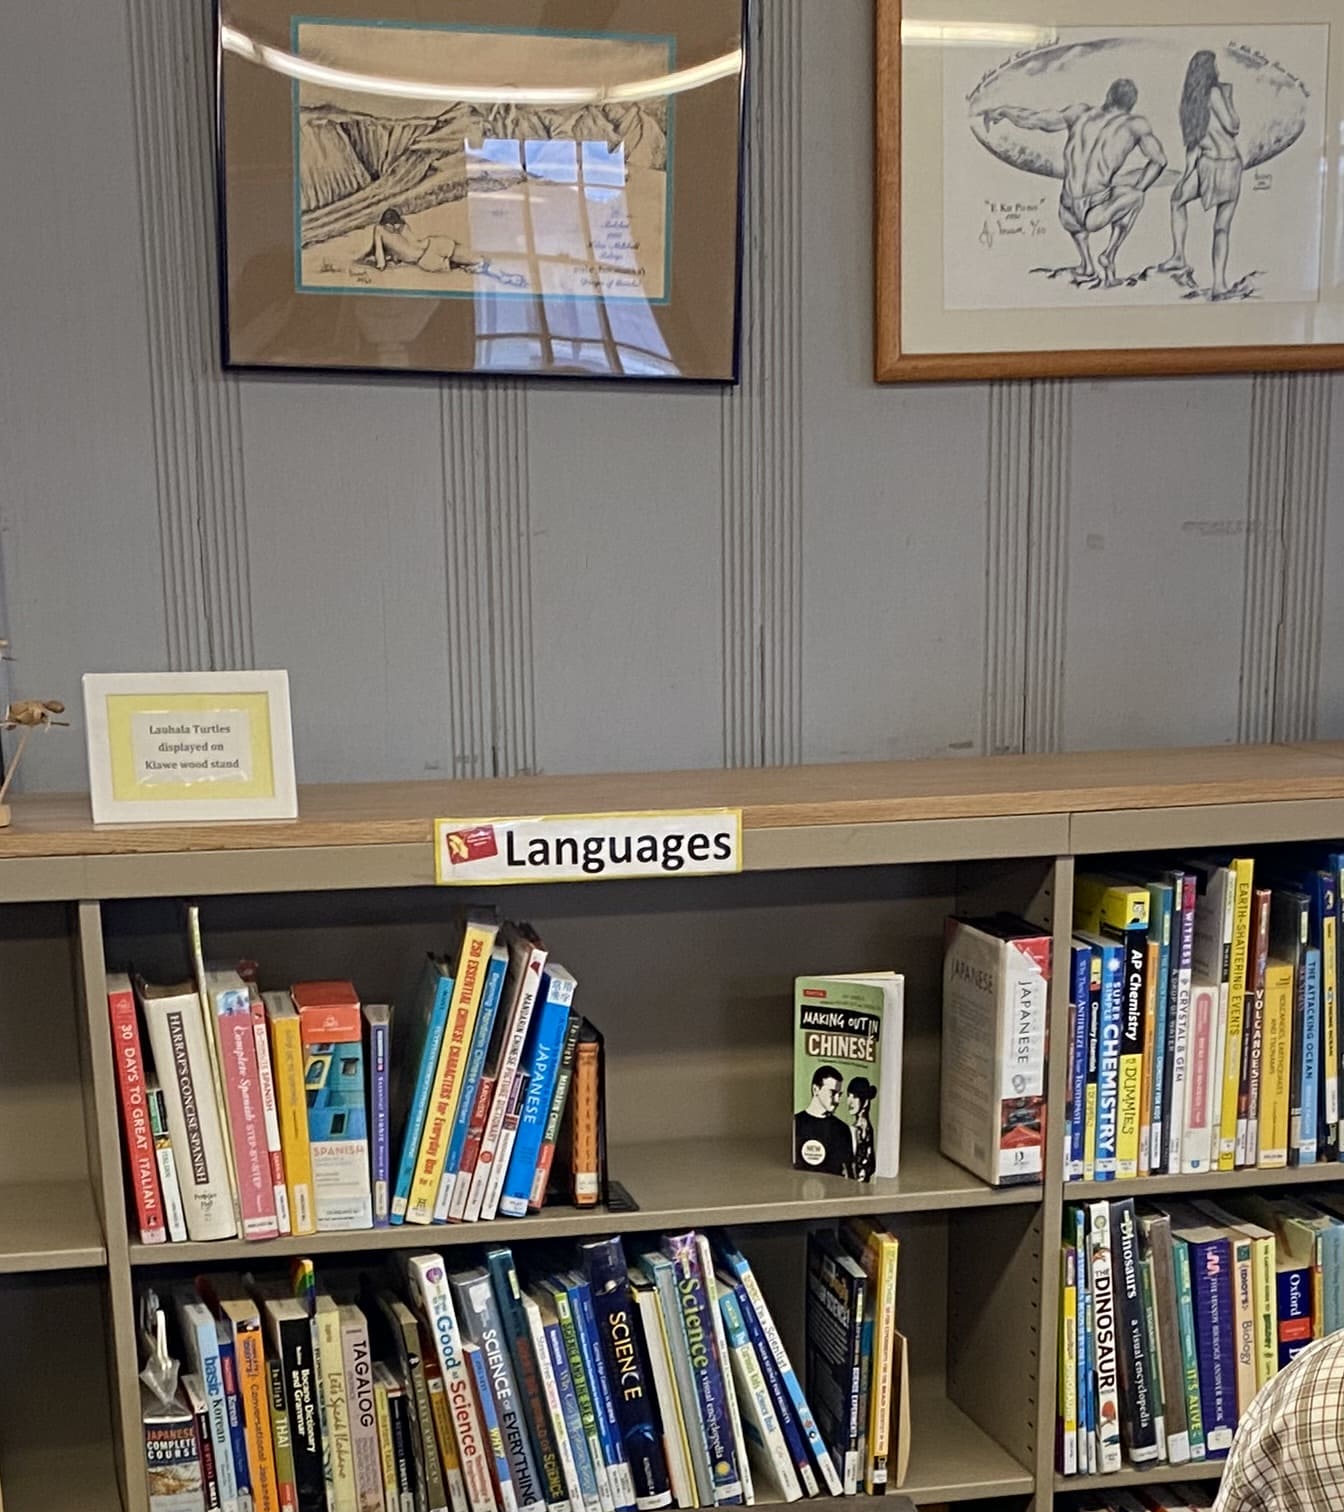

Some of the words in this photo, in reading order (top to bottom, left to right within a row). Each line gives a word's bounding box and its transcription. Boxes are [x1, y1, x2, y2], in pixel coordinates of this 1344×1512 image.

[150, 725, 190, 734] Lauhala
[192, 725, 231, 733] Turtles
[159, 742, 208, 754] displayed
[180, 760, 208, 768] wood
[211, 760, 239, 768] stand
[507, 831, 731, 873] Languages
[1132, 950, 1143, 968] AP
[1308, 962, 1316, 981] THE
[803, 1012, 845, 1027] MAKING
[848, 1018, 866, 1031] OUT
[1018, 980, 1029, 1065] JAPANESE
[1126, 970, 1142, 1040] Chemistry
[1307, 985, 1315, 1041] ATTACKING
[120, 1025, 133, 1040] 30
[808, 1035, 874, 1061] CHINESE
[124, 1049, 139, 1082] DAYS
[1305, 1044, 1314, 1079] OCEAN
[129, 1086, 141, 1105] TO
[523, 1044, 550, 1124] JAPANESE
[1099, 1024, 1119, 1152] CHEMISTRY
[133, 1110, 147, 1149] GREAT
[139, 1159, 155, 1209] ITALIAN
[1290, 1274, 1302, 1316] Oxford
[679, 1279, 708, 1367] Science
[1095, 1276, 1115, 1389] DINOSAUR
[610, 1312, 642, 1401] SCIENCE
[353, 1341, 374, 1427] TAGALOG
[483, 1330, 511, 1399] SCIENCE
[504, 1411, 536, 1505] EVERYTHING
